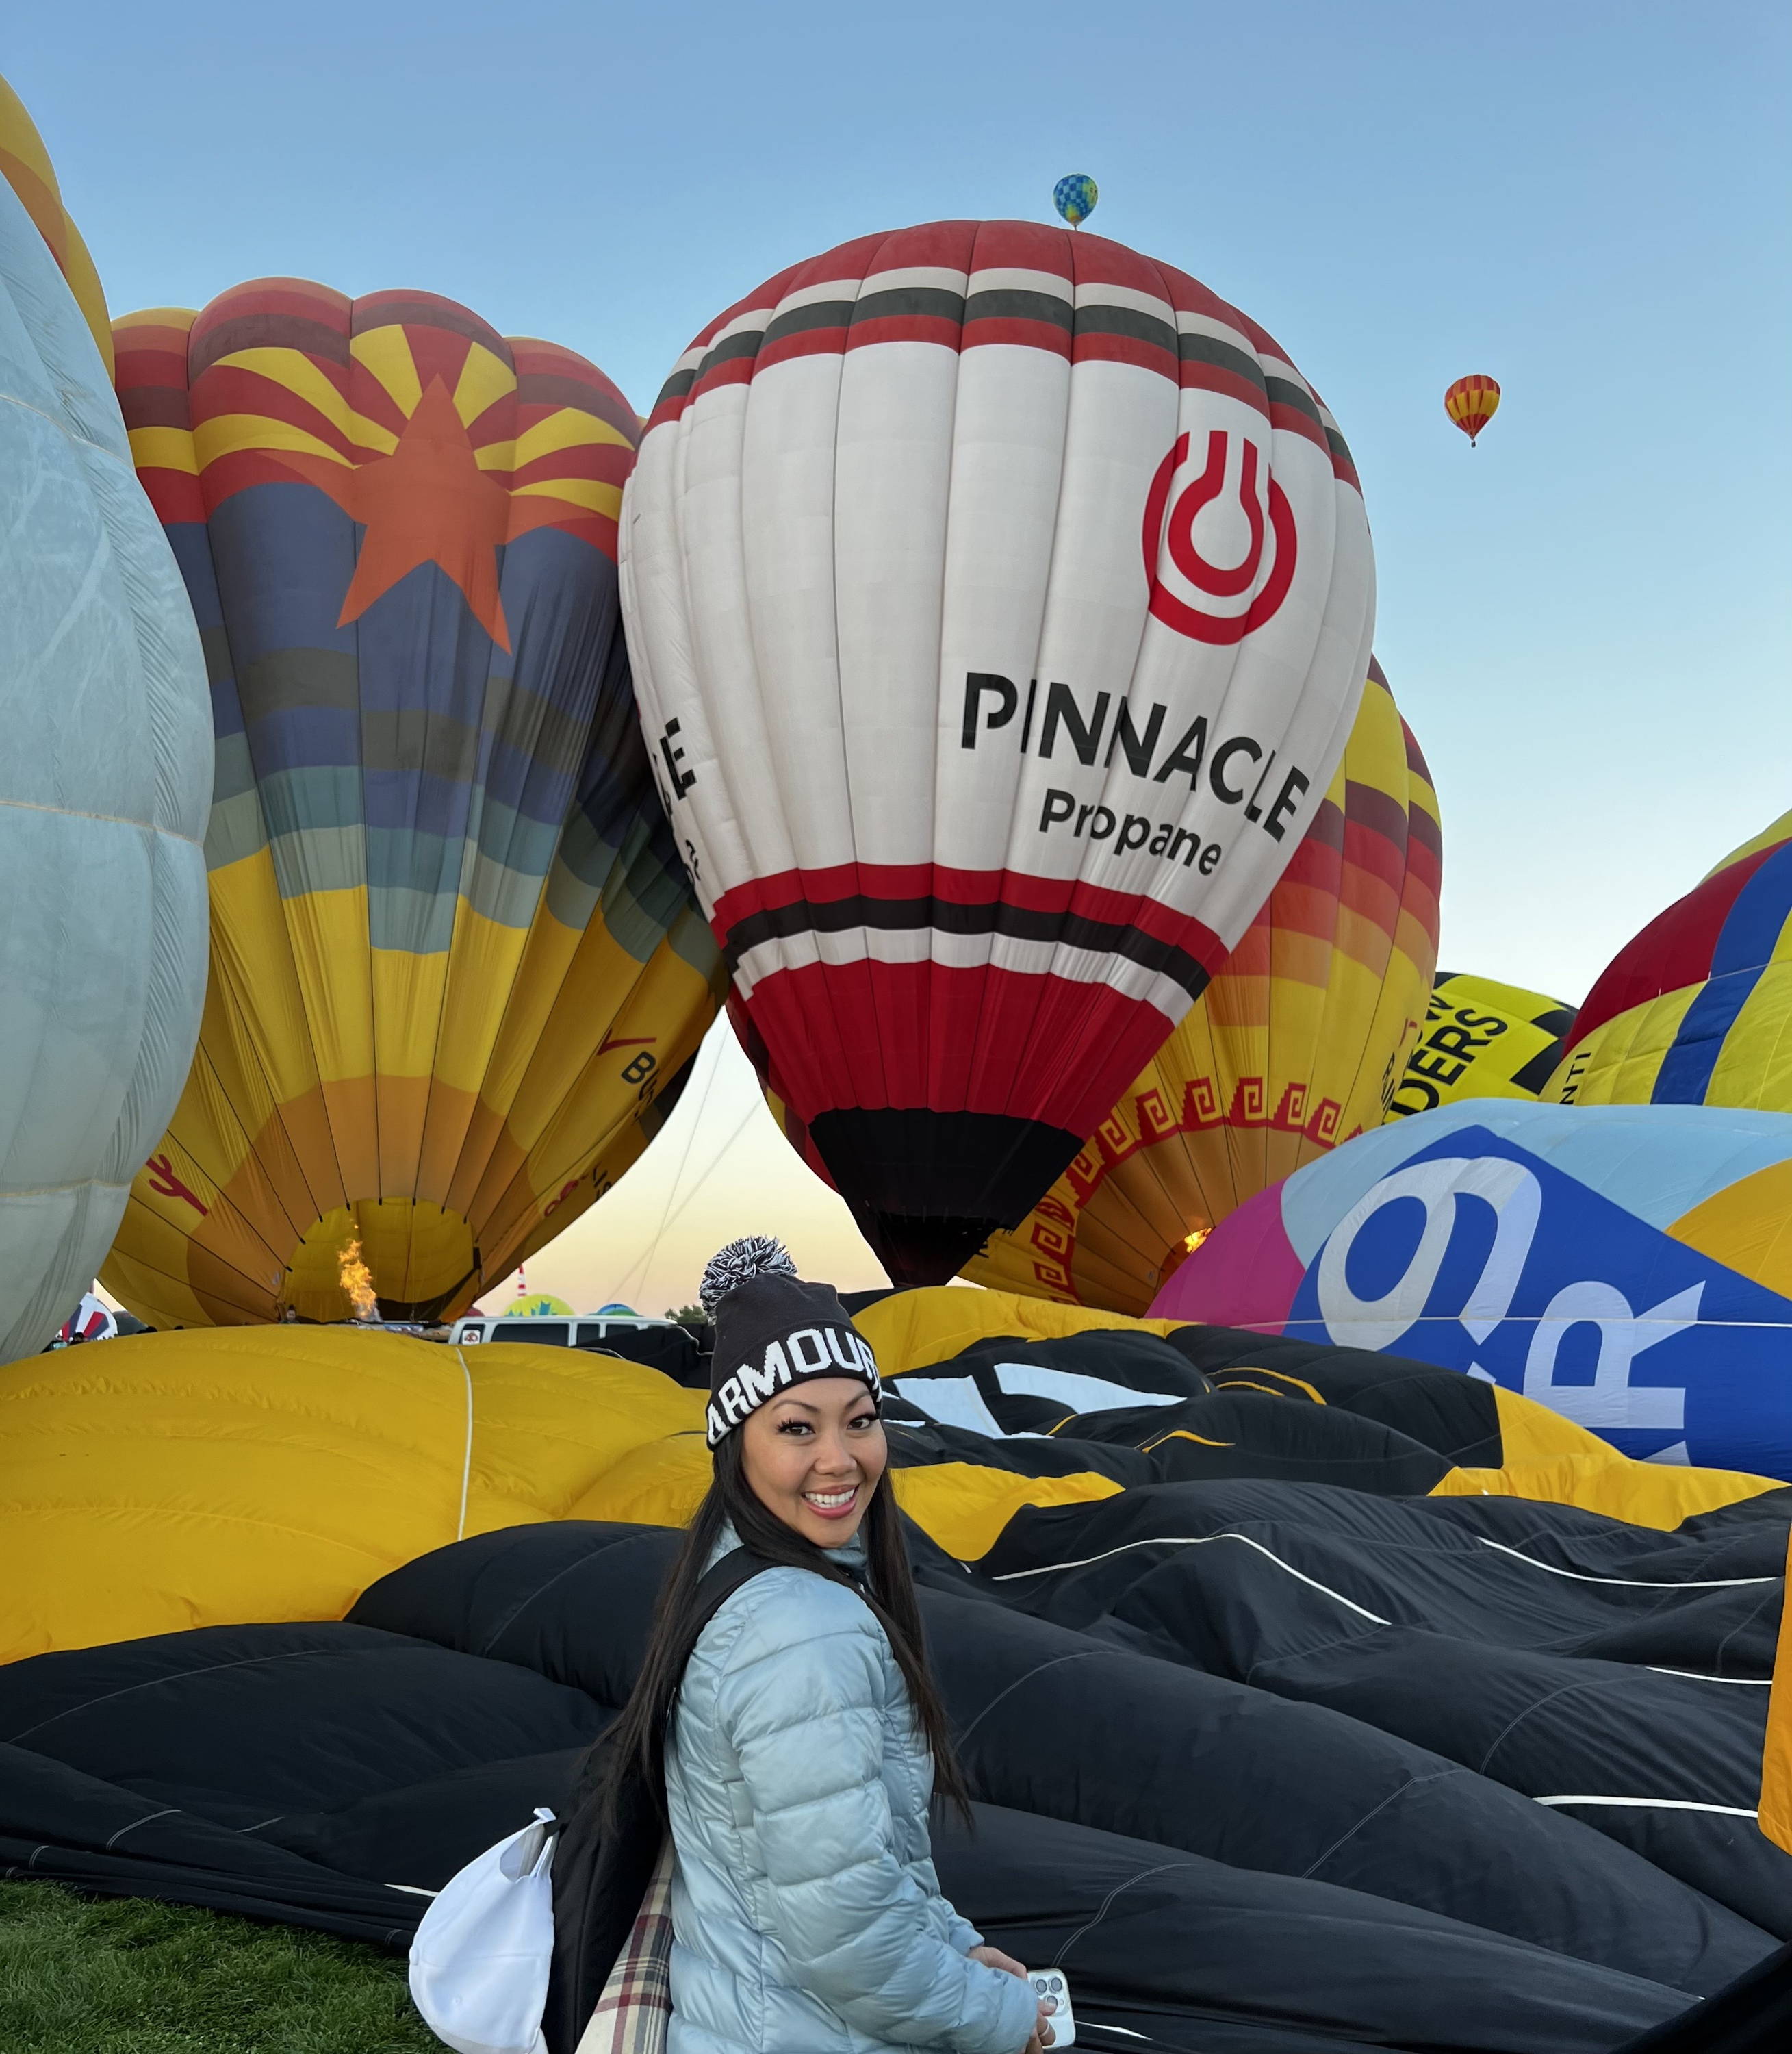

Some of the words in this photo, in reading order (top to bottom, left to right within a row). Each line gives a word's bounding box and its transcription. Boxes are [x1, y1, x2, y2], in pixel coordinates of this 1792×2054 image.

[961, 672, 1310, 843] PINNACLE
[1039, 788, 1223, 876] Propane
[707, 1327, 880, 1445] ARMOUR
[1523, 1280, 1706, 1467] R
